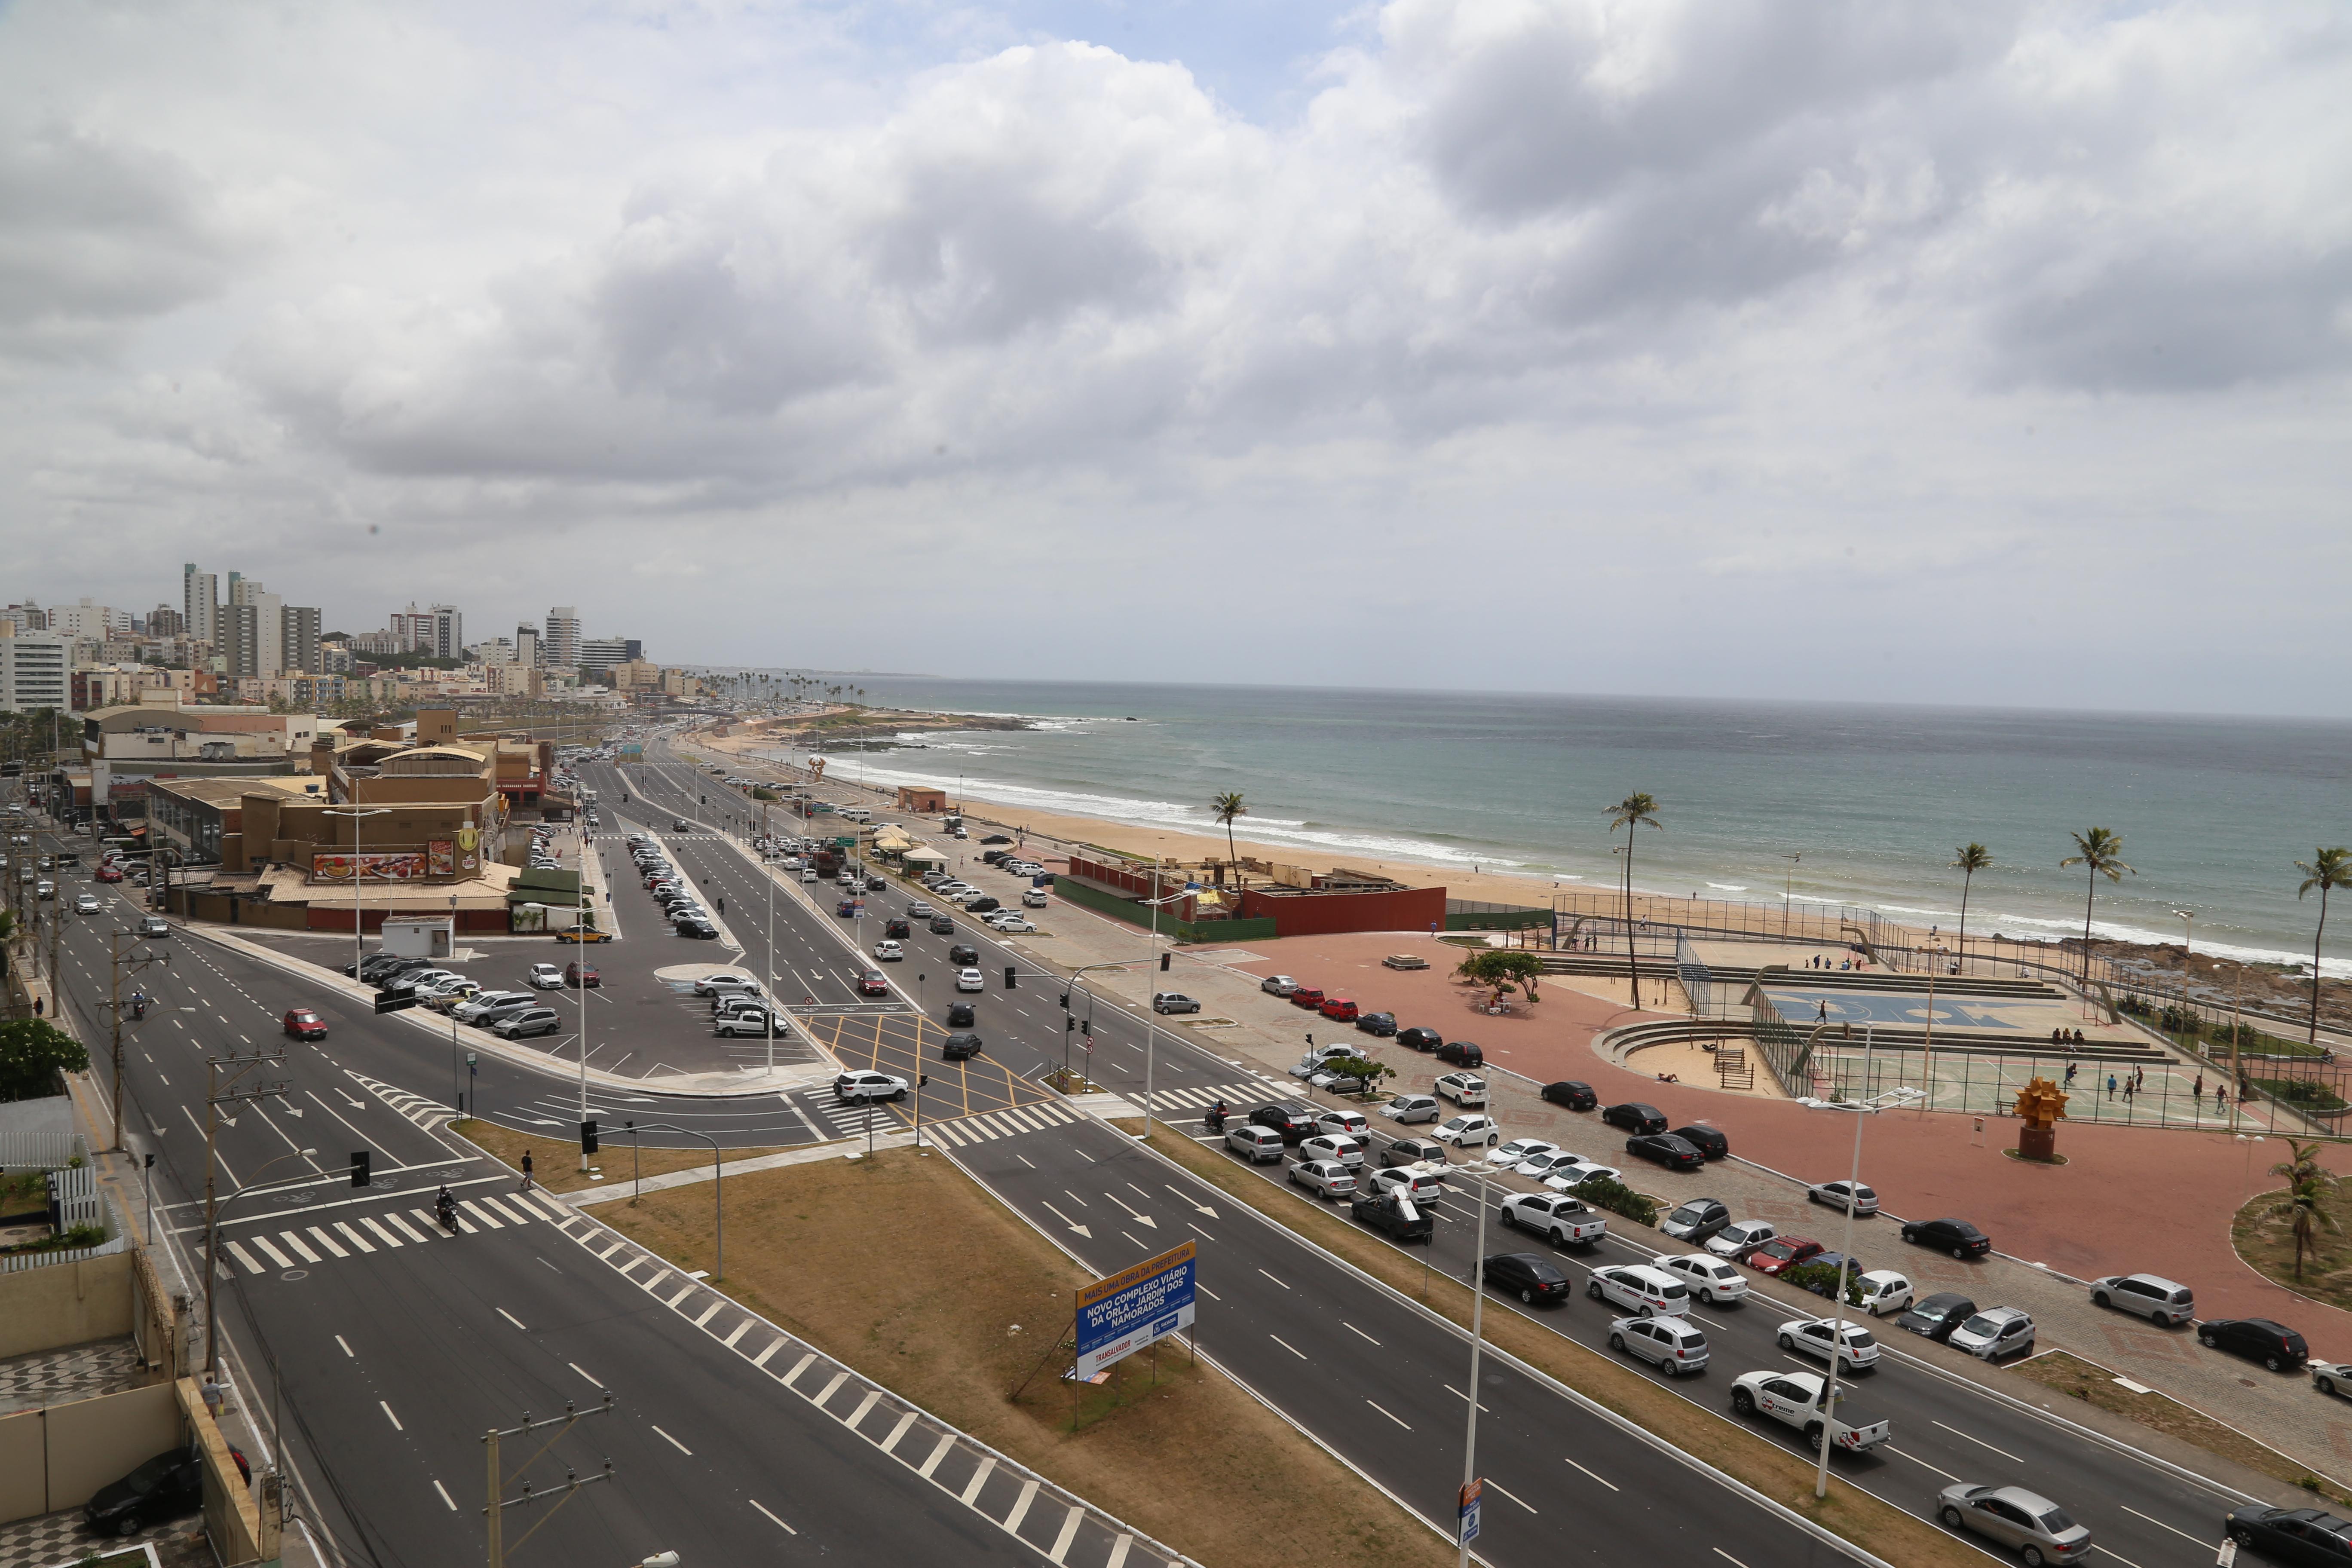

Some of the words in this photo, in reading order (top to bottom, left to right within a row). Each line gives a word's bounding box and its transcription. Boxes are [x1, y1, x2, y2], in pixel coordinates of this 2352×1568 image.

[1084, 1286, 1102, 1302] MAIS
[1104, 1280, 1119, 1293] UMA
[1121, 1271, 1139, 1285] OBRA
[1141, 1266, 1150, 1277] DA
[1152, 1248, 1190, 1272] PREFEITURA
[1087, 1300, 1112, 1319] NOVO
[1114, 1279, 1159, 1306] COMPLEXO
[1161, 1266, 1187, 1285] VIÁRIO
[1092, 1314, 1104, 1328] DA
[1106, 1303, 1129, 1320] ORLA
[1136, 1286, 1166, 1307] JARDIM
[1167, 1277, 1183, 1292] DOS
[1112, 1295, 1165, 1328] NAMORADOS
[1161, 1317, 1176, 1327] SALVADOR
[1096, 1340, 1130, 1363] TRANSALVADOR
